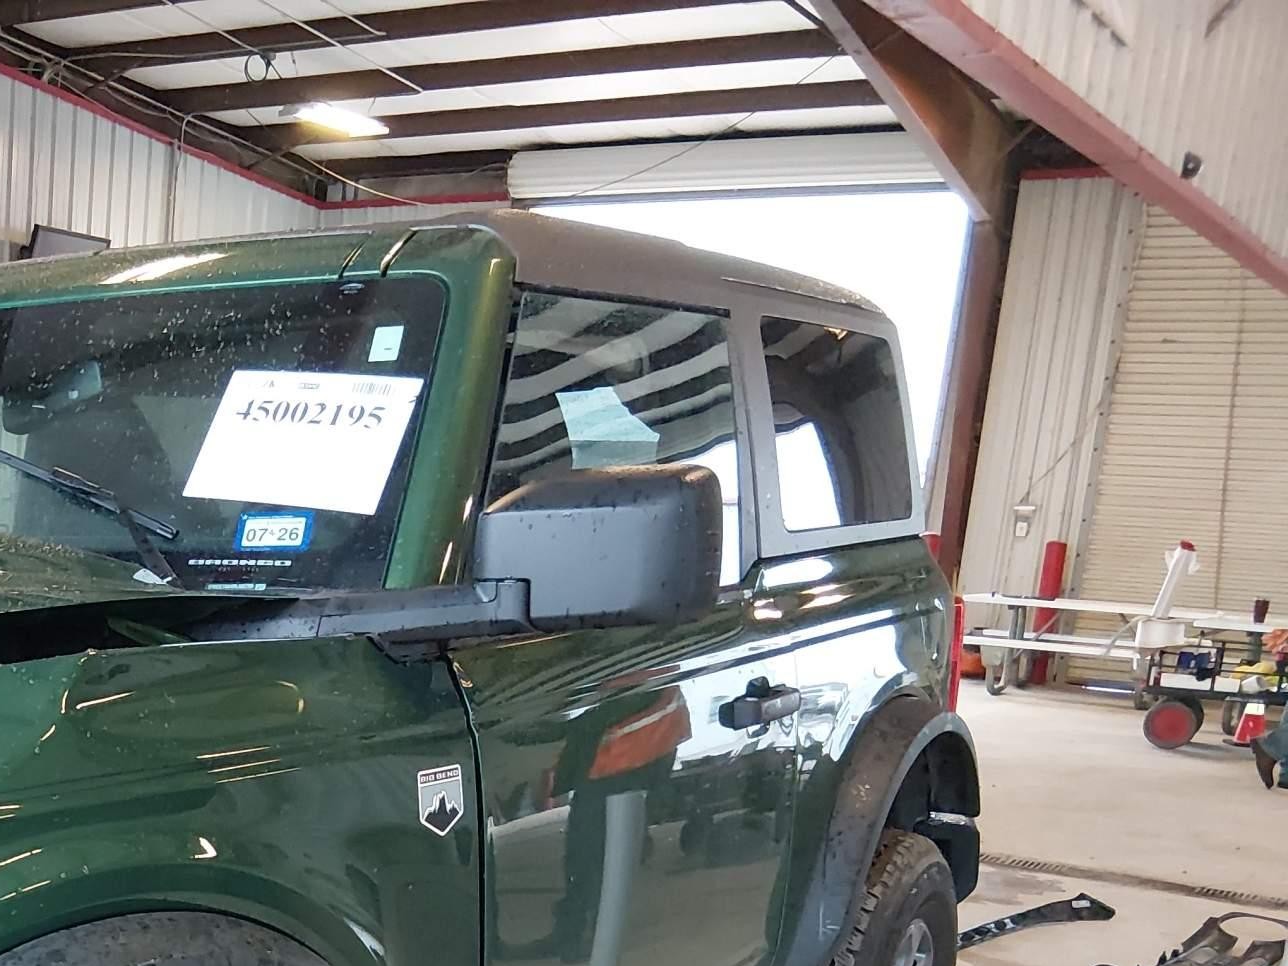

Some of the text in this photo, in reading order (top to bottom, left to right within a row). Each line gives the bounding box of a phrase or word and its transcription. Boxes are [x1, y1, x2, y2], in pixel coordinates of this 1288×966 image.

[236, 400, 387, 429] 45002195
[245, 527, 300, 543] 07 26
